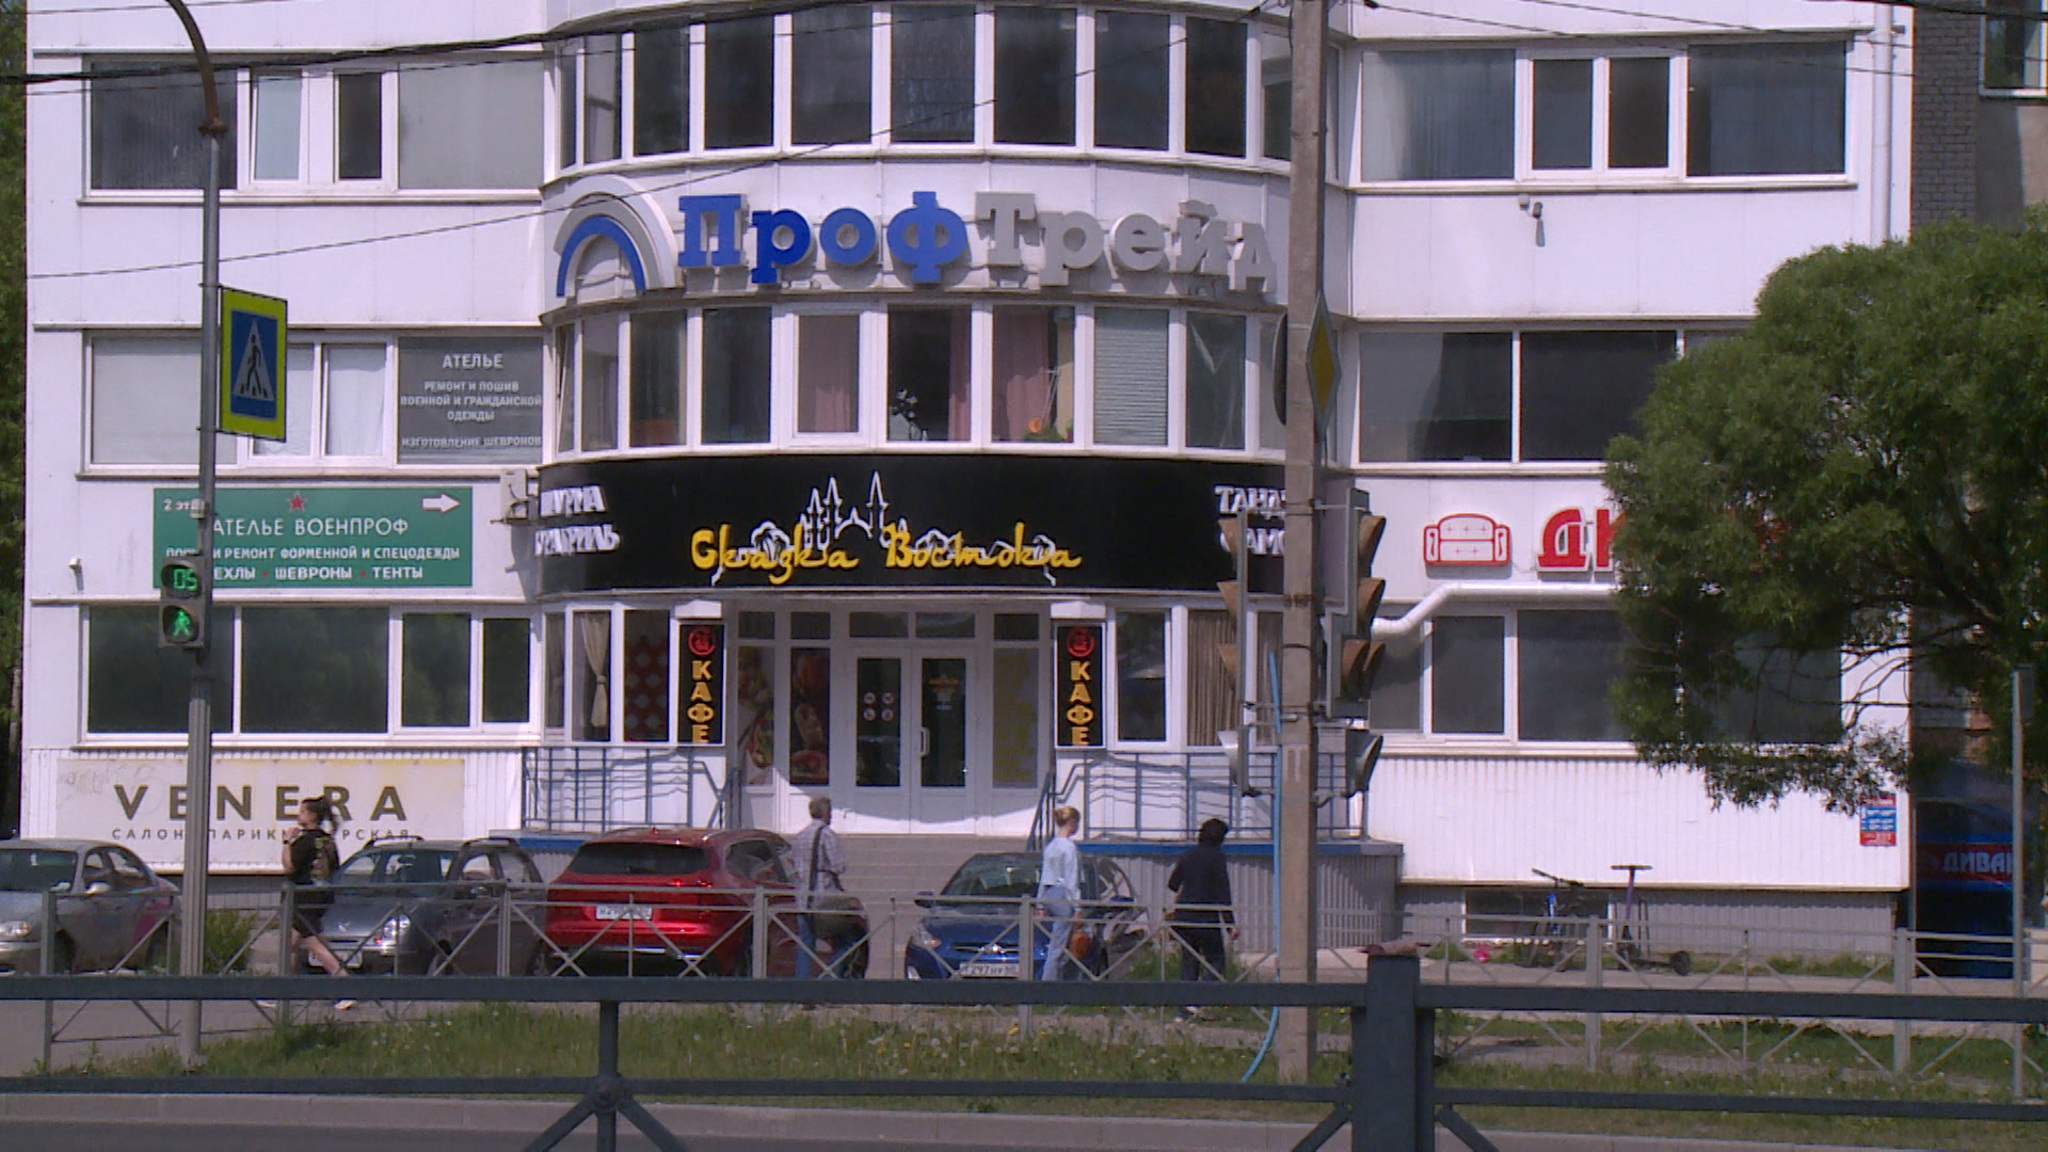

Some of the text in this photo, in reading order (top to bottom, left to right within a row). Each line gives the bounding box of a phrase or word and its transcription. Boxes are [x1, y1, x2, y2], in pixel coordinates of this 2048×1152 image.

[678, 190, 1275, 292] ПрофТрейд
[442, 353, 504, 369] АТЕЛЬЕ
[424, 381, 519, 392] РЕМОНТ И ПОШИВ
[400, 394, 542, 407] ВОЕННОЙ И ГРАЖДАНСКОЙ
[446, 410, 495, 422] ОДЕЖДЫ
[401, 436, 542, 448] ИЗГОТОВЛЕНИЕ ШЕВРОНОВ
[163, 498, 173, 511] 2
[213, 517, 409, 536] АТЕЛЬЕ ВОЕНПРОФ
[213, 547, 222, 559] И
[223, 547, 275, 559] РЕМОНТ
[280, 545, 358, 559] ФОРМЕННОЙ
[361, 547, 371, 559] И
[373, 546, 460, 560] СПЕЦОДЕЖДЫ
[690, 521, 1082, 585] Сказка Востока
[213, 566, 423, 580] ЕХЛЫ ШЕВРОНЫ ТЕНТЫ
[687, 660, 715, 744] КАФЕ
[1066, 660, 1094, 746] КАФЕ
[111, 828, 183, 840] САЛОН
